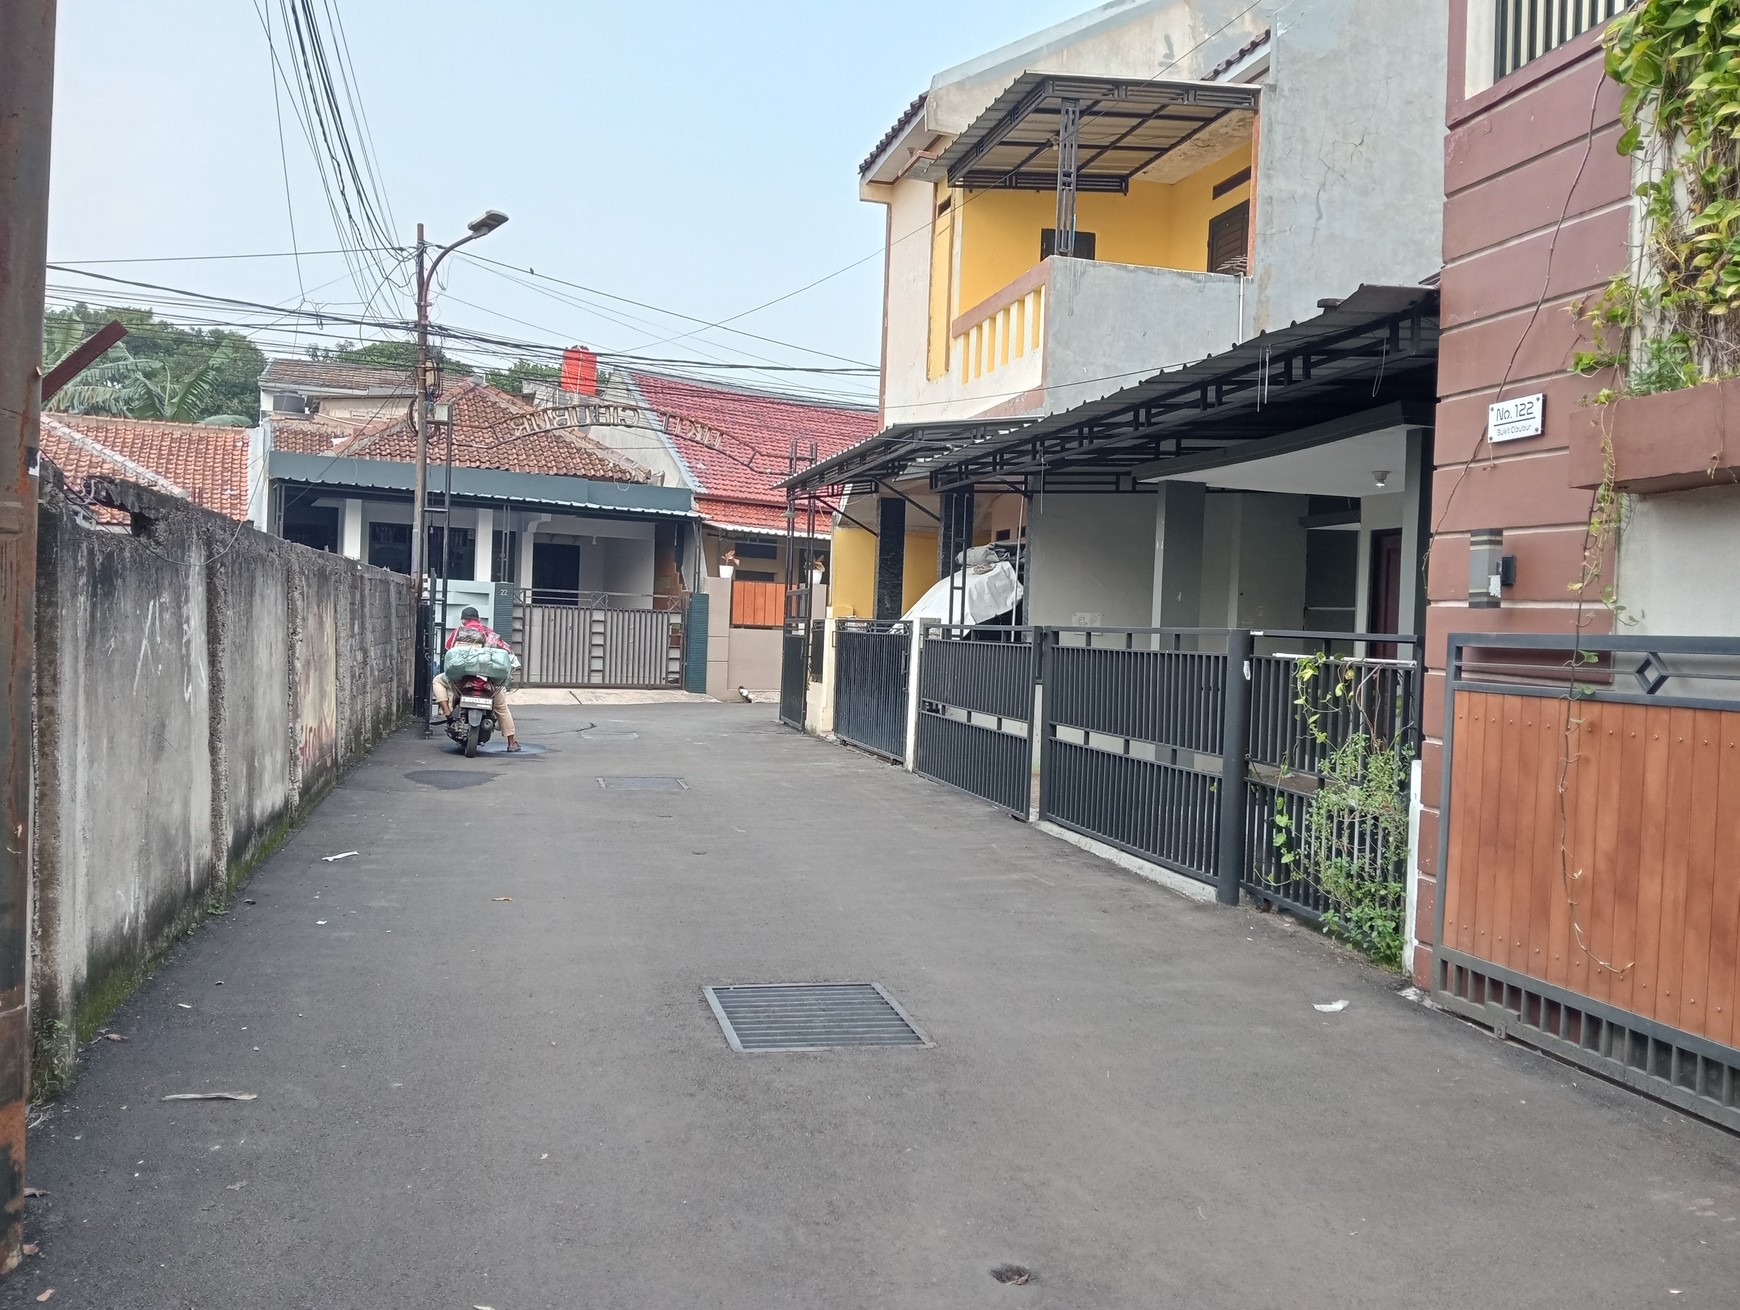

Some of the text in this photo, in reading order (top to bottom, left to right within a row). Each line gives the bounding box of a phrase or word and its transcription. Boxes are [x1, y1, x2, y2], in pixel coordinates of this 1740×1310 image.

[1496, 401, 1534, 422] No. 122
[500, 588, 508, 596] 22
